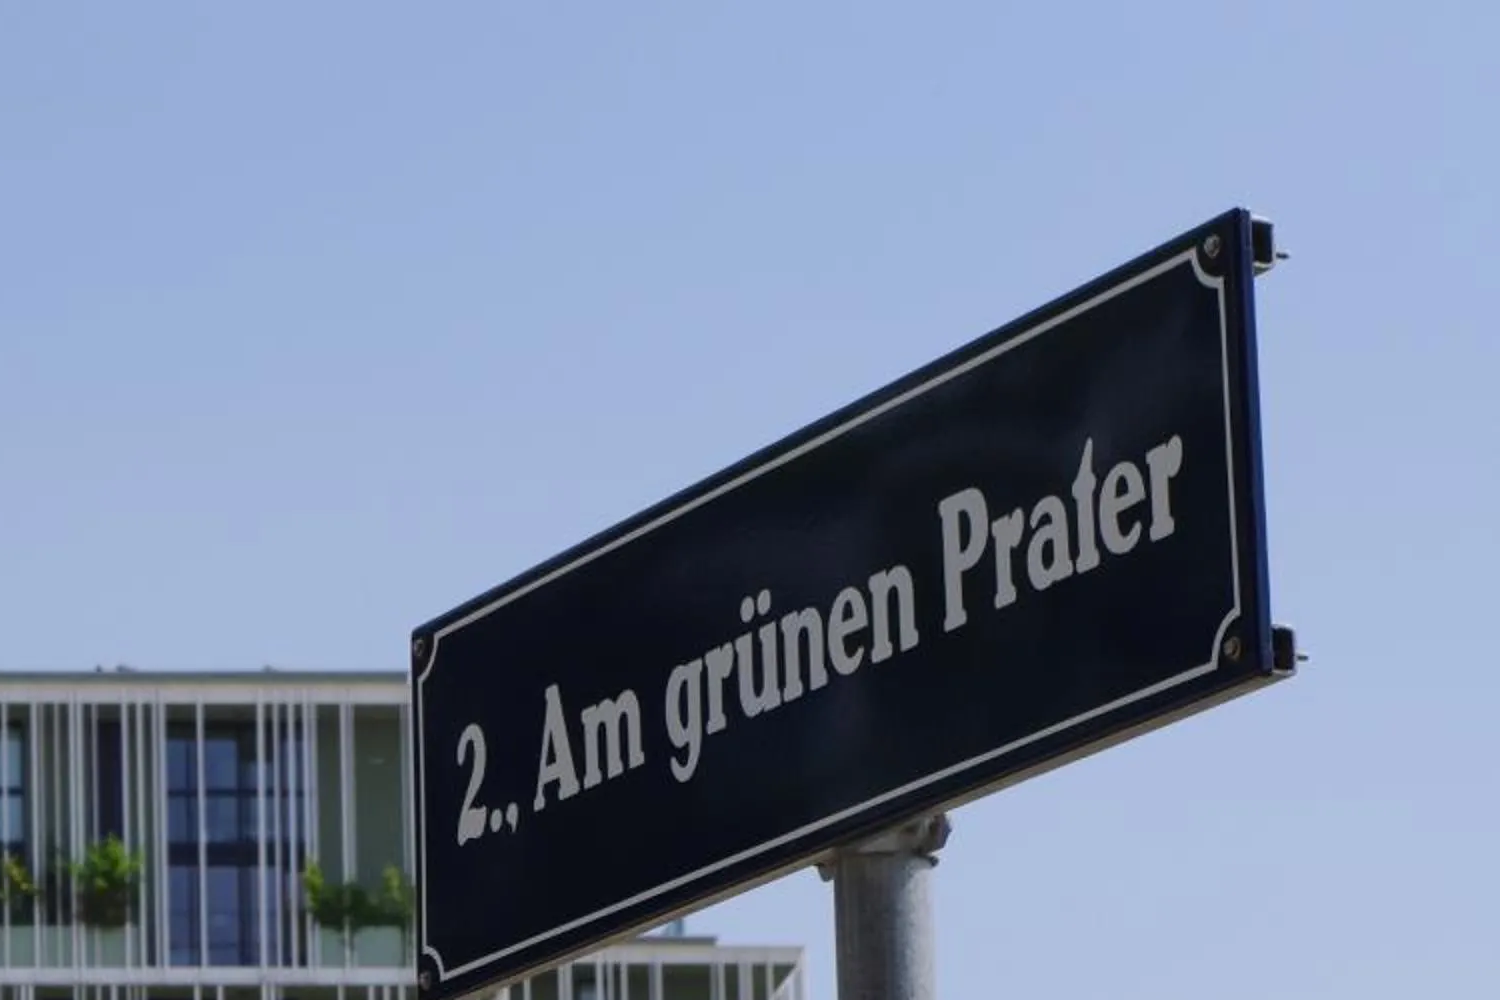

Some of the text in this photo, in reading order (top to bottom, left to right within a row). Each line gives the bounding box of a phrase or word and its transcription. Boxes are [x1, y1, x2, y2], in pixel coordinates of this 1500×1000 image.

[456, 435, 1182, 846] 2., Am grünen Prater
